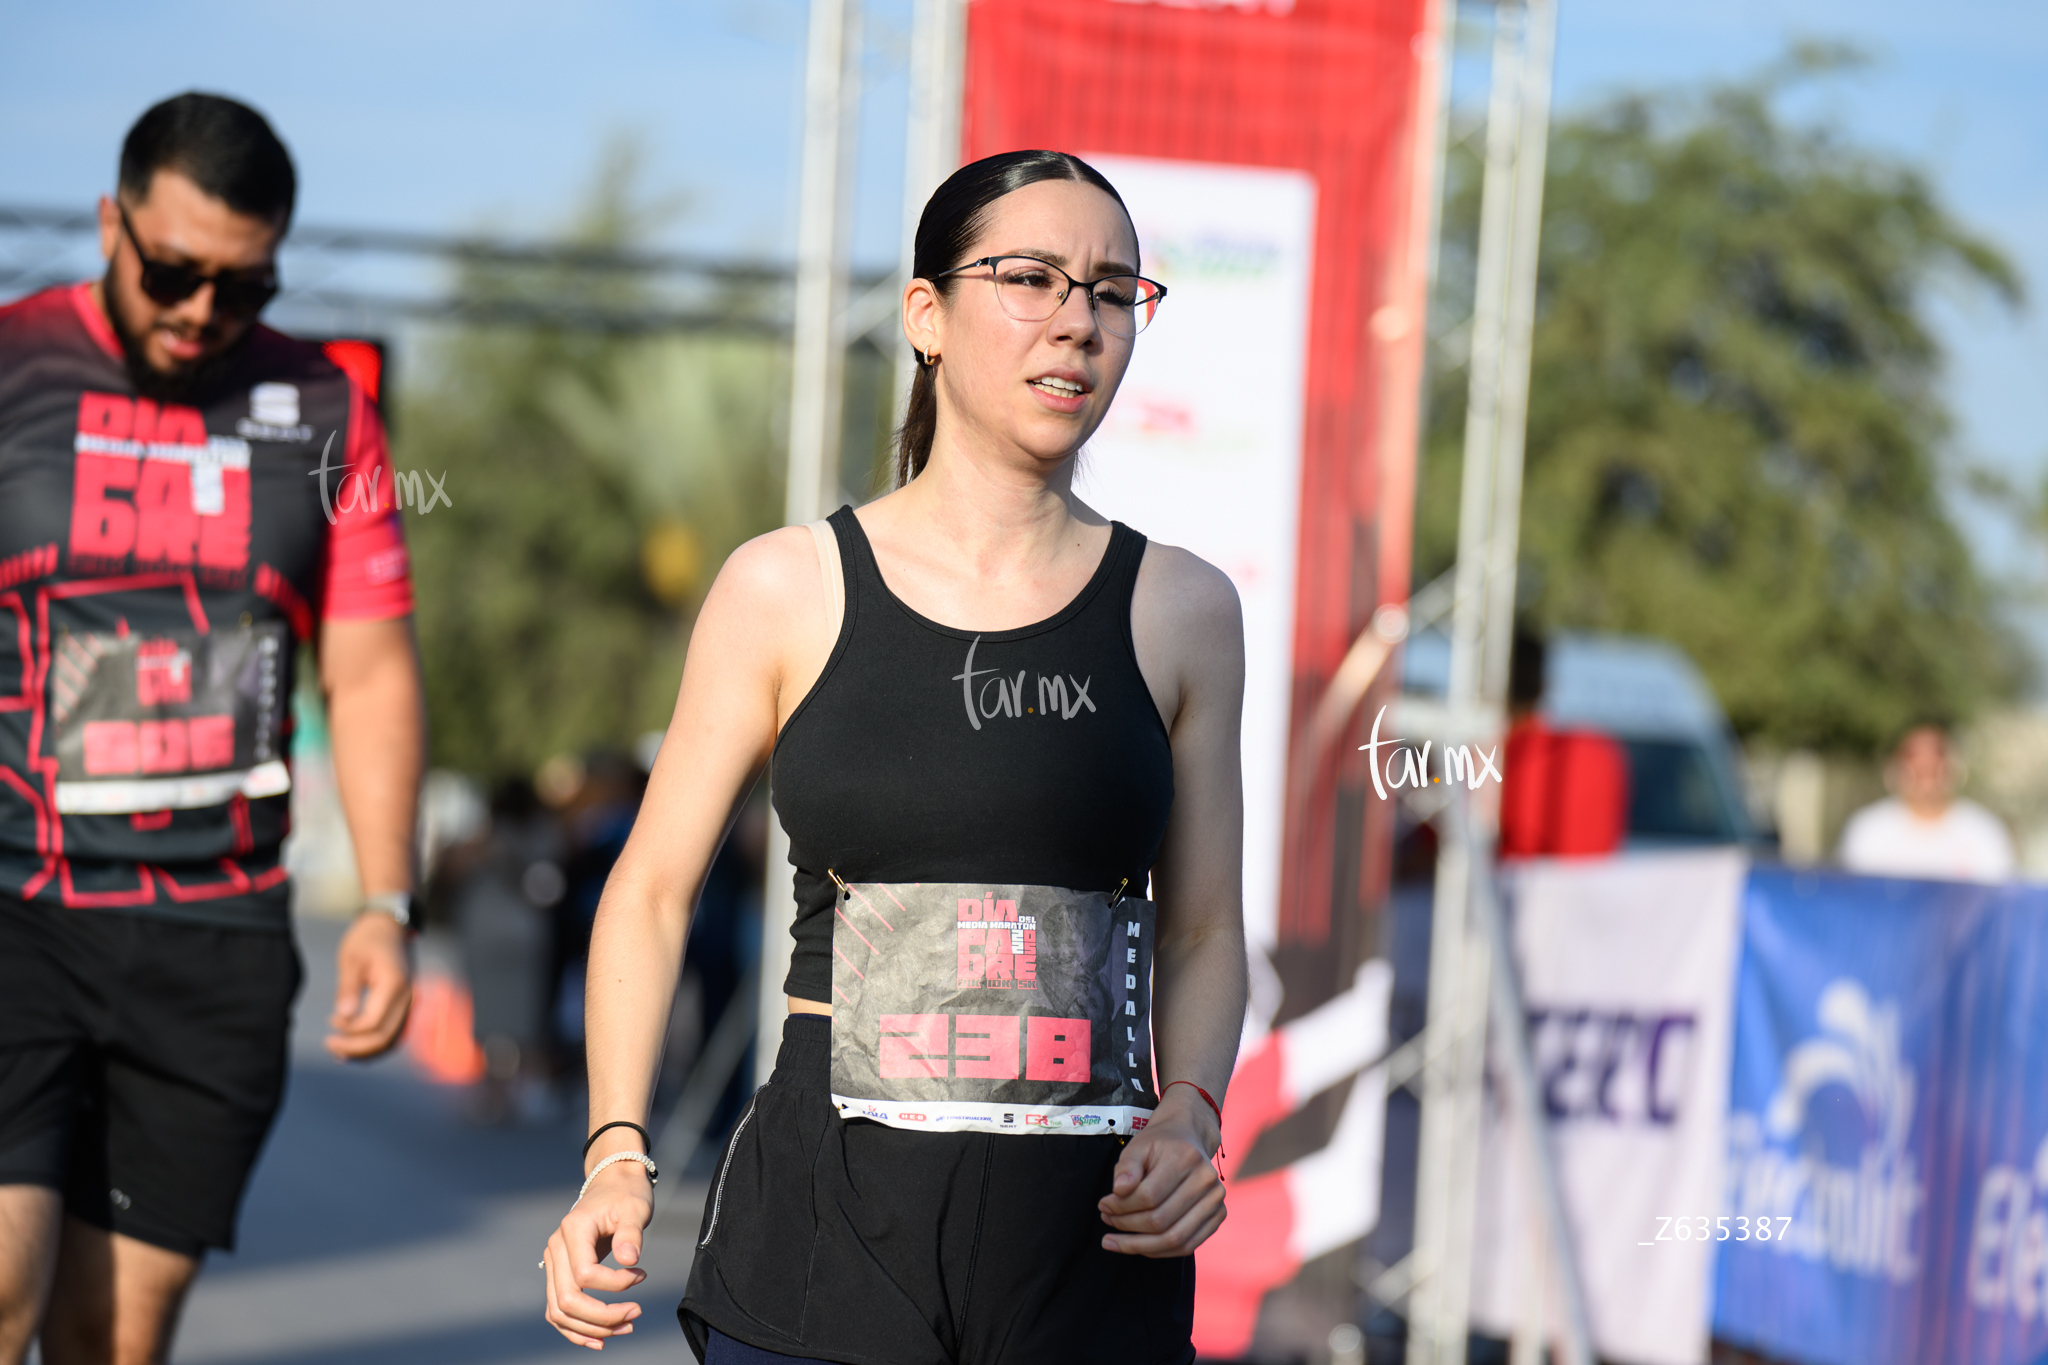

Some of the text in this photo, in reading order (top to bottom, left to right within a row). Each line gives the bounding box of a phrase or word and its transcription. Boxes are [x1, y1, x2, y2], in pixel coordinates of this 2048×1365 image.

[1018, 915, 1036, 923] DEL
[957, 921, 988, 929] MEDIA
[956, 979, 1037, 990] 21K 10K 5K
[1125, 921, 1144, 1092] MEDALLA
[879, 1013, 1091, 1083] 238
